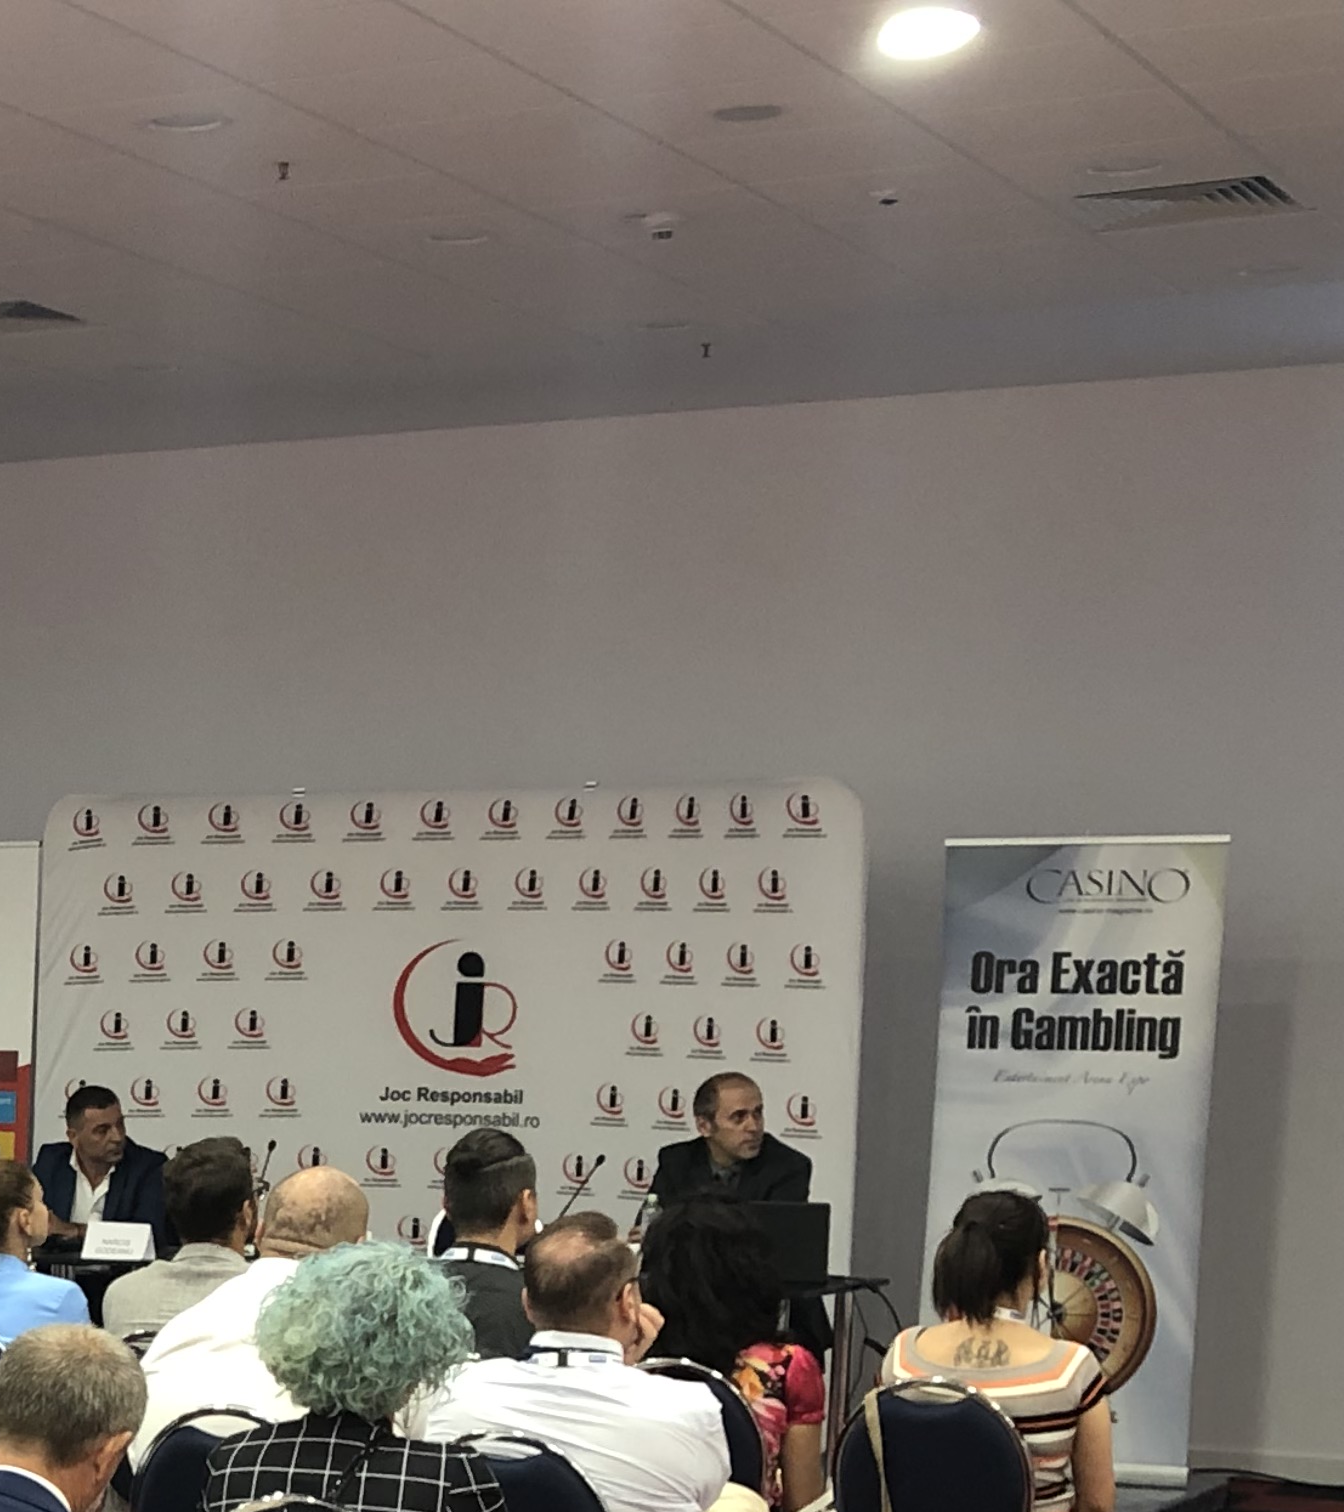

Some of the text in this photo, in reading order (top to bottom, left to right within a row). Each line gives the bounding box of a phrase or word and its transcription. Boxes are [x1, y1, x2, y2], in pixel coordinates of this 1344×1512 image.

[1026, 867, 1191, 905] CASINO
[970, 949, 1186, 996] Ora Exactă
[965, 1005, 1182, 1060] în Gambling
[379, 1086, 524, 1106] Joc Responsabil
[359, 1109, 541, 1129] www.jocresponsabil.ro
